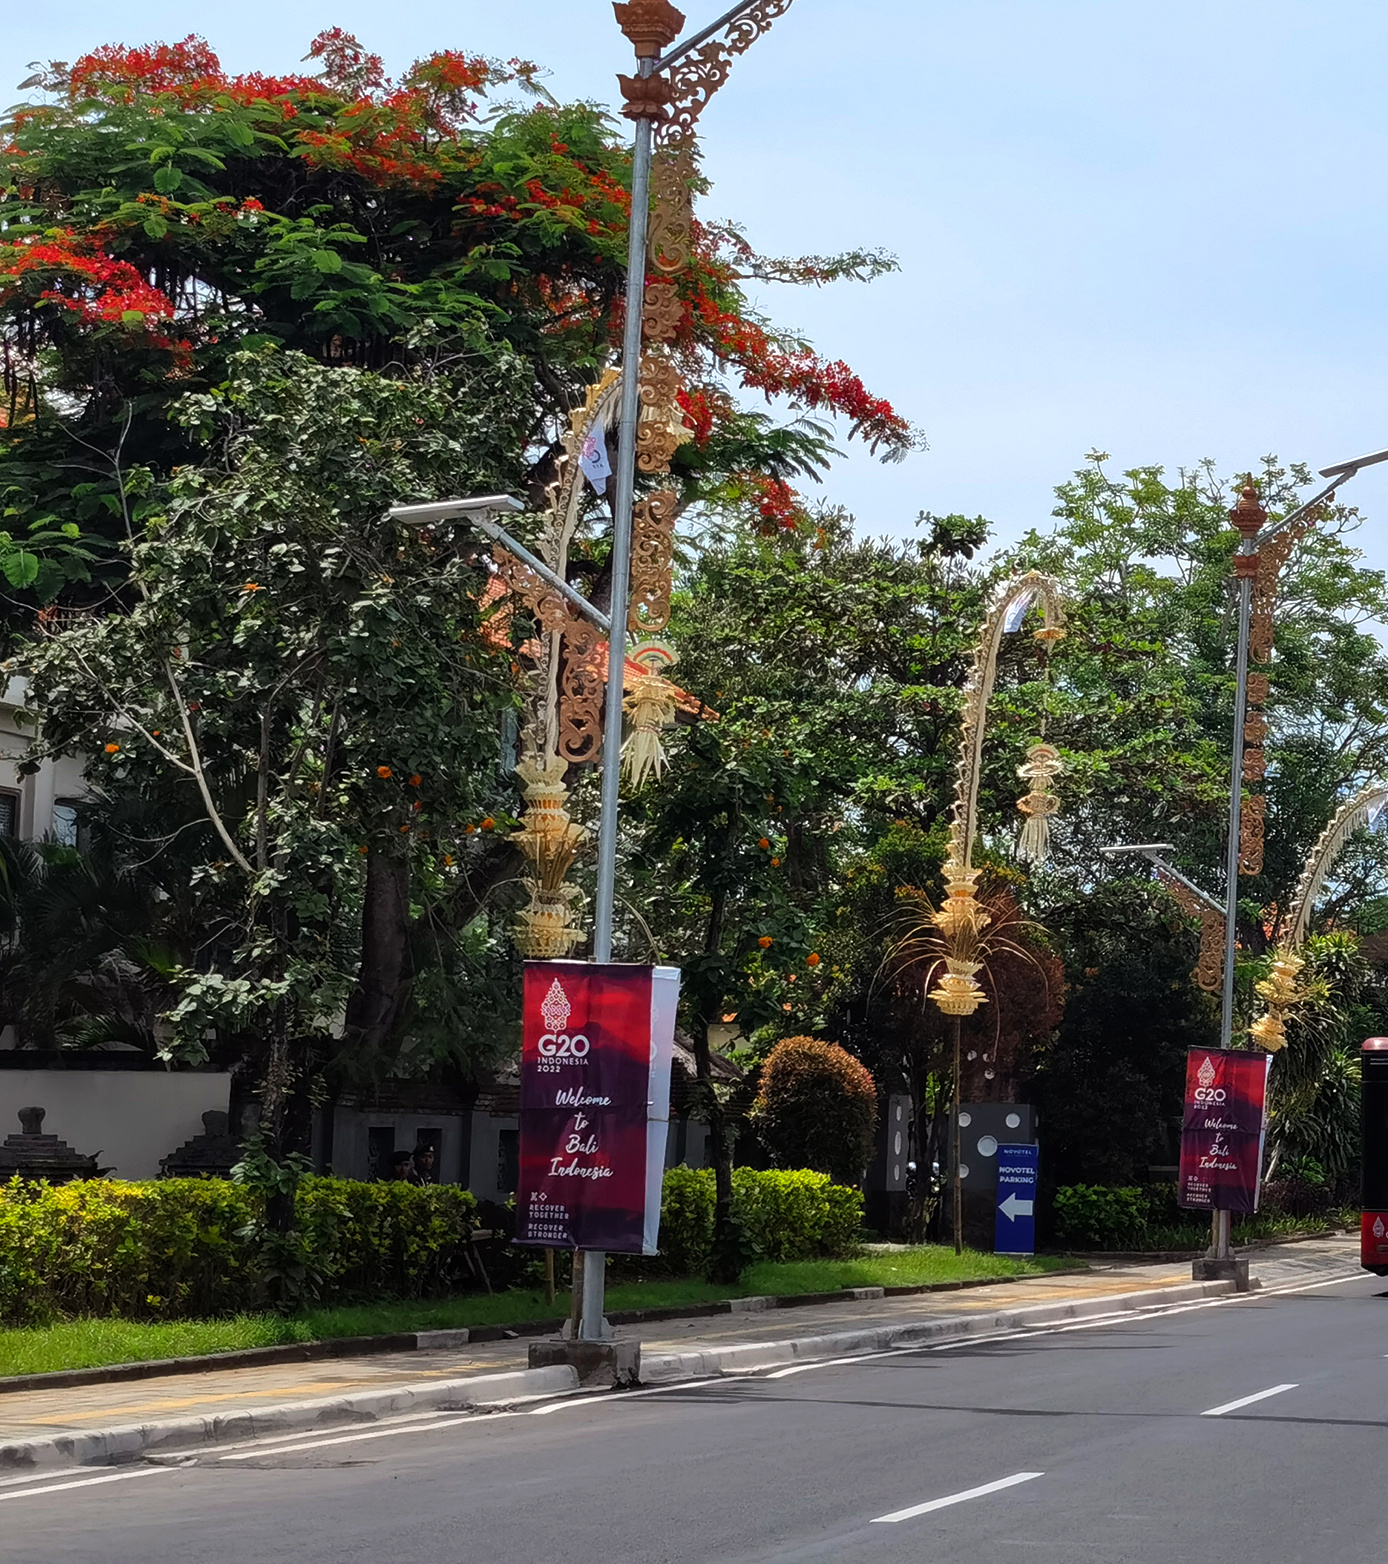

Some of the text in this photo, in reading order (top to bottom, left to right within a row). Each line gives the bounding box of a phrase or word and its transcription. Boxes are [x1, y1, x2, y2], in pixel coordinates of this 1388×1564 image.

[538, 1034, 590, 1057] G20
[537, 1057, 589, 1066] INDONESIA
[555, 1086, 612, 1106] Welcome
[1194, 1088, 1226, 1102] G20
[574, 1111, 589, 1131] to
[1204, 1118, 1238, 1130] Welcome
[565, 1134, 599, 1154] Bali
[548, 1156, 614, 1180] Indonesia
[999, 1166, 1035, 1174] NOVOTEL
[1199, 1156, 1238, 1171] Indonesia
[999, 1176, 1034, 1184] PARKING
[529, 1204, 565, 1212] RECOVER
[529, 1211, 570, 1220] TOGETHER
[528, 1223, 564, 1231] RECOVER
